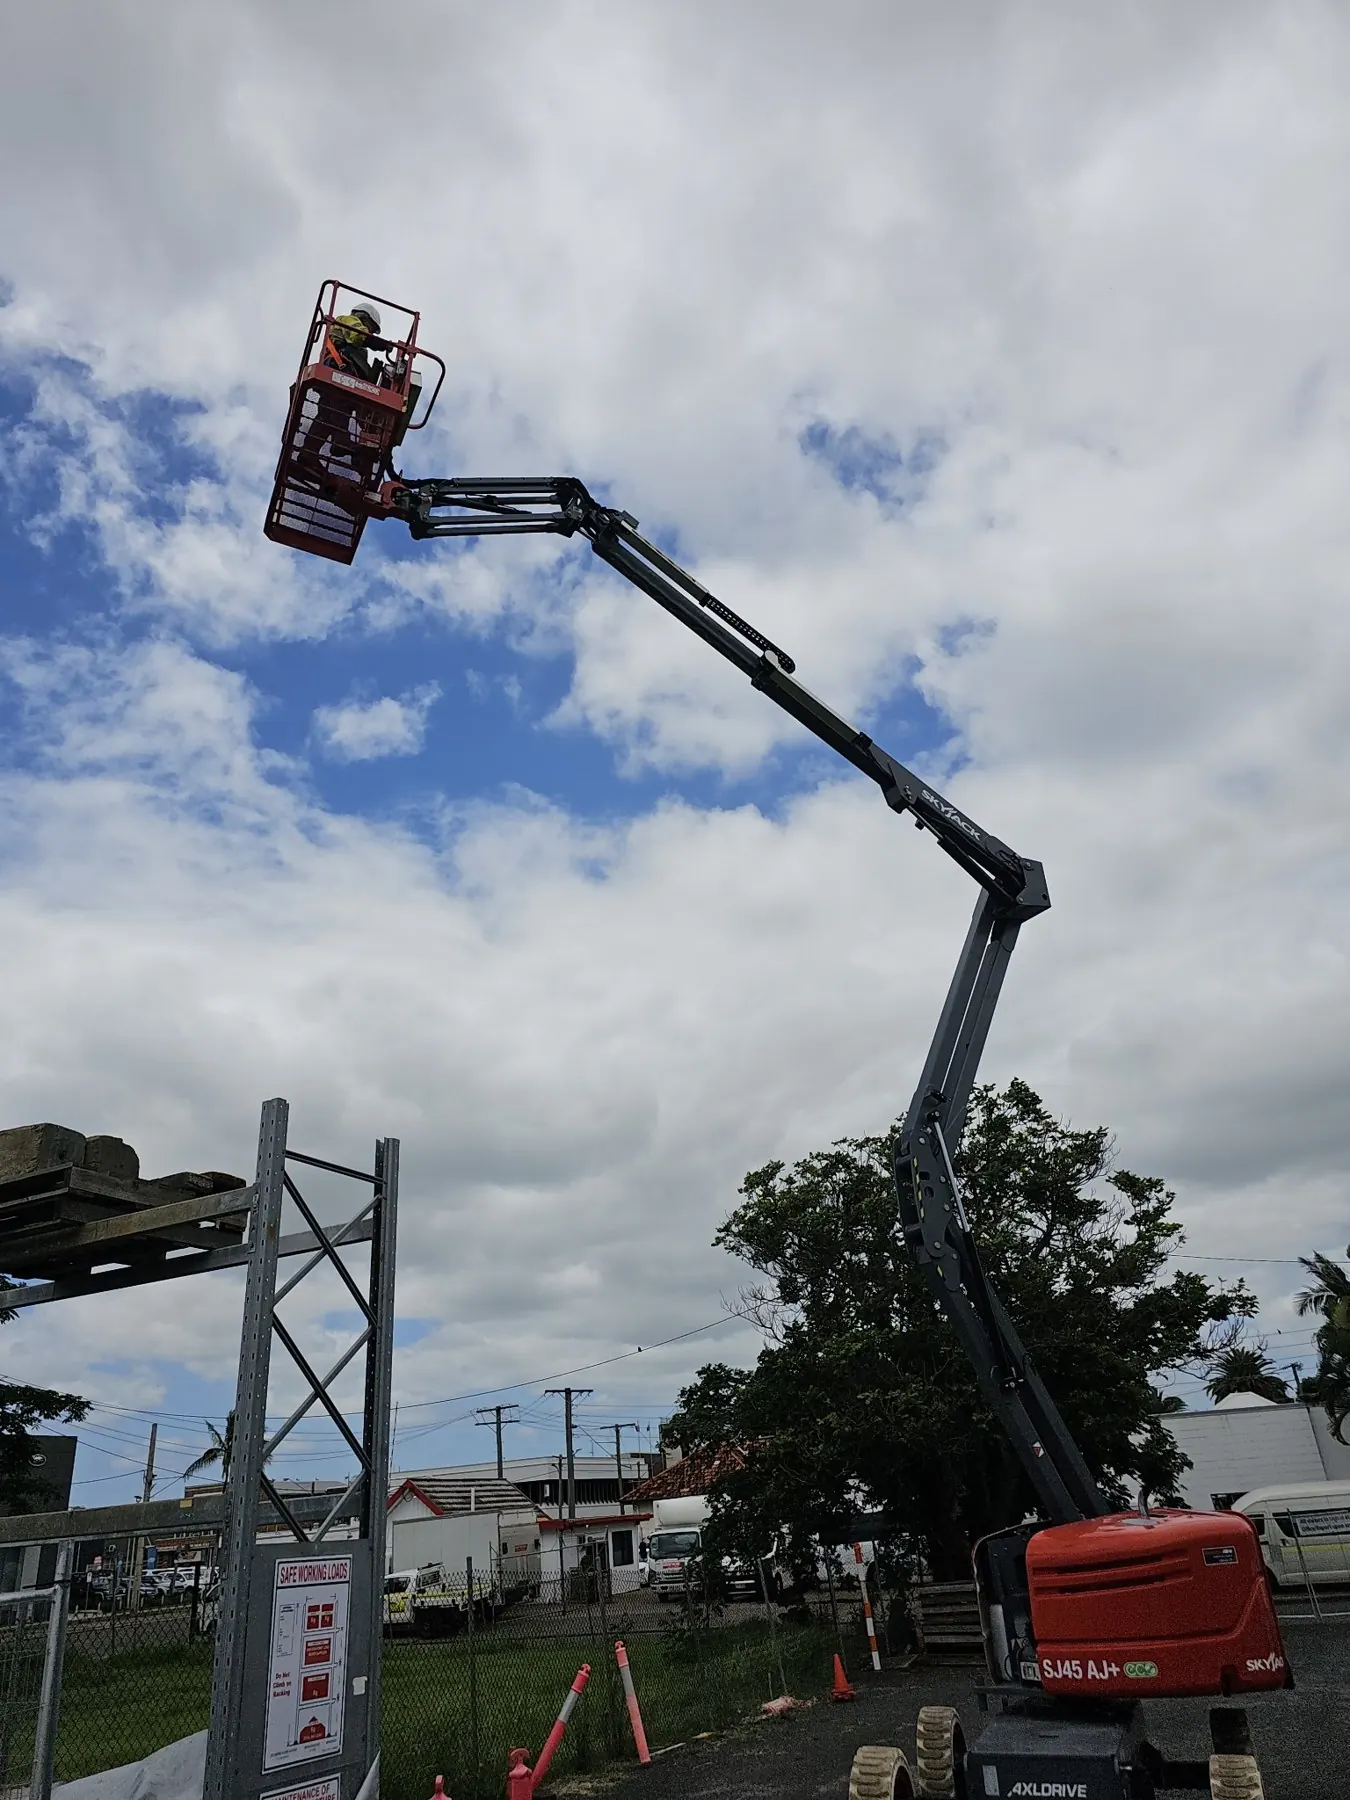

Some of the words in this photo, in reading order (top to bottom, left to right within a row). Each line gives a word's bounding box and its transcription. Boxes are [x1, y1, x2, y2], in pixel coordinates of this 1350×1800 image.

[921, 789, 981, 841] SKYJACK
[280, 1566, 298, 1584] SAFE
[299, 1563, 327, 1582] WORKING
[328, 1562, 348, 1580] LOADS
[1042, 1659, 1082, 1679] SJ45
[1087, 1660, 1120, 1679] AJ+
[273, 1689, 290, 1697] Racking
[321, 1784, 330, 1795] OF
[1007, 1782, 1088, 1798] AXLDRIVE
